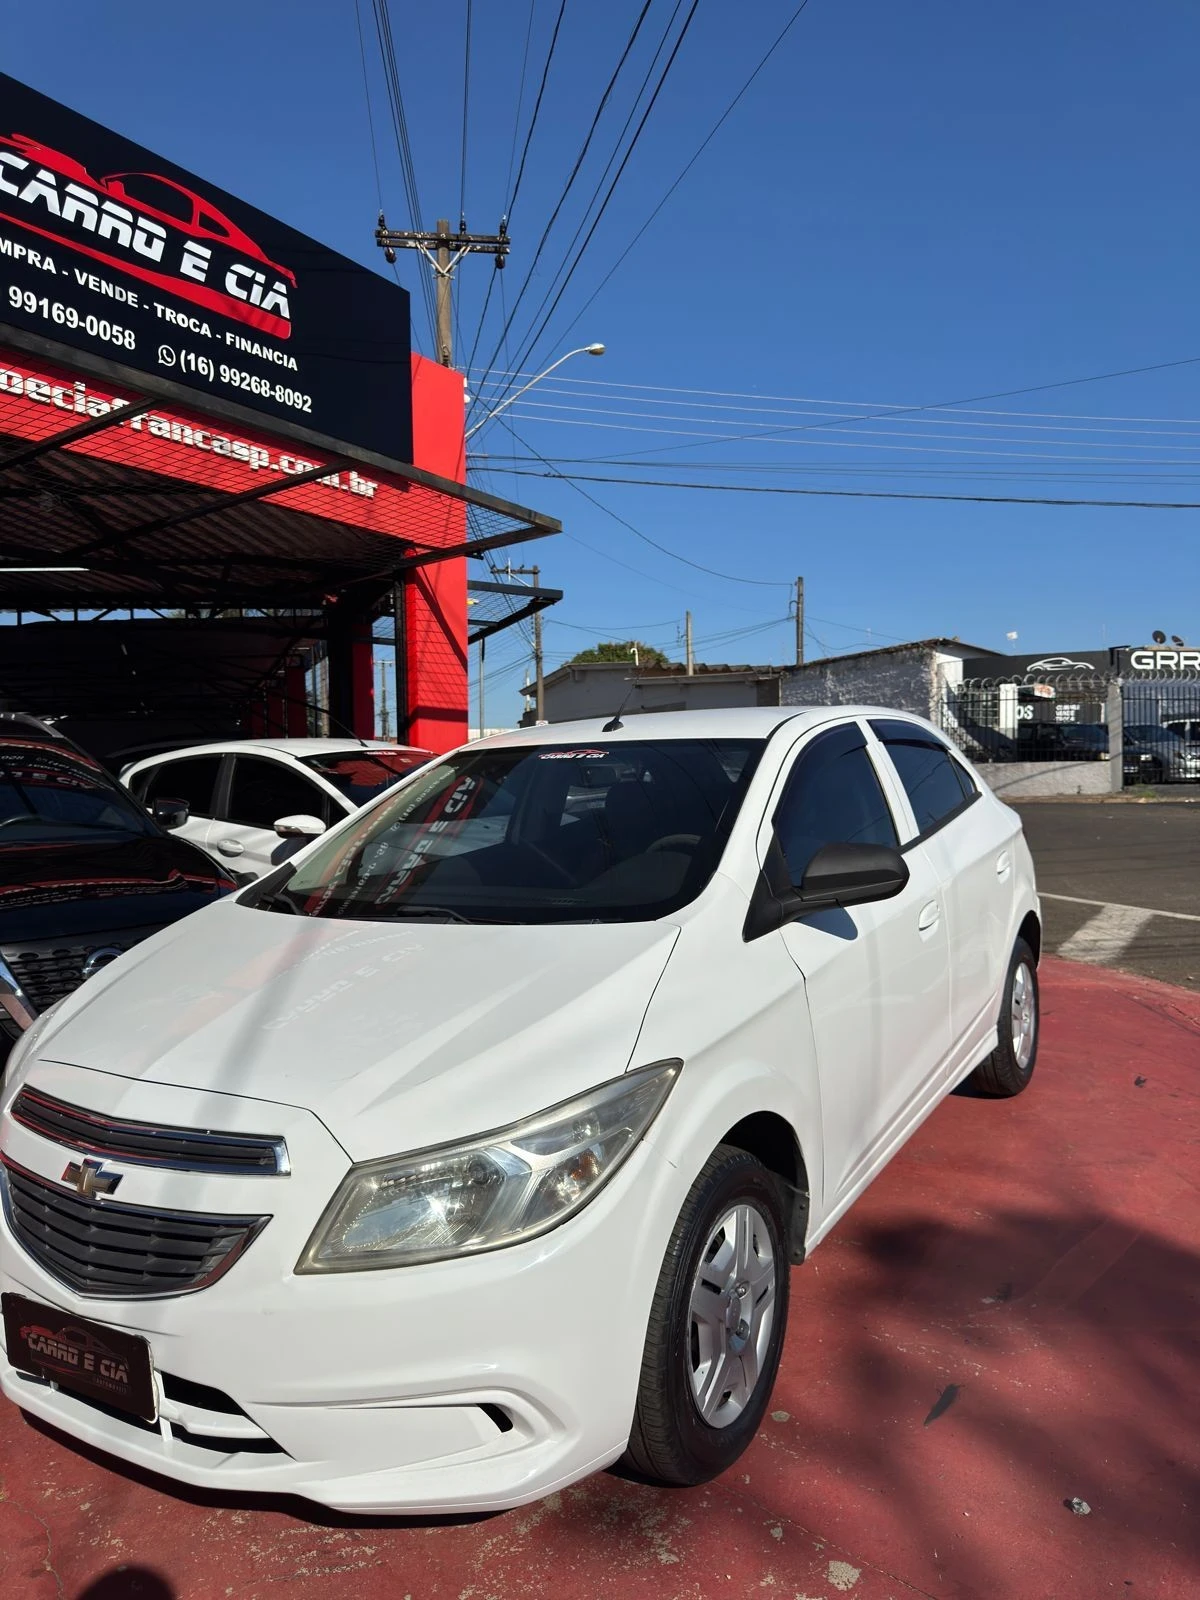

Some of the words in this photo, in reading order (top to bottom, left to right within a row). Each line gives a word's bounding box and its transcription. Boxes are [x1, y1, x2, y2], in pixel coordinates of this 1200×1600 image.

[0, 151, 167, 263] CARRO
[179, 240, 212, 283] E
[8, 285, 136, 350] 99169-0058
[73, 268, 139, 309] VENDE
[153, 302, 212, 338] TROCA
[225, 331, 298, 371] FINANCIA
[180, 349, 215, 382] (16)
[219, 364, 312, 413] 99268-8092
[27, 1332, 79, 1366] CARRO
[83, 1352, 95, 1371] E
